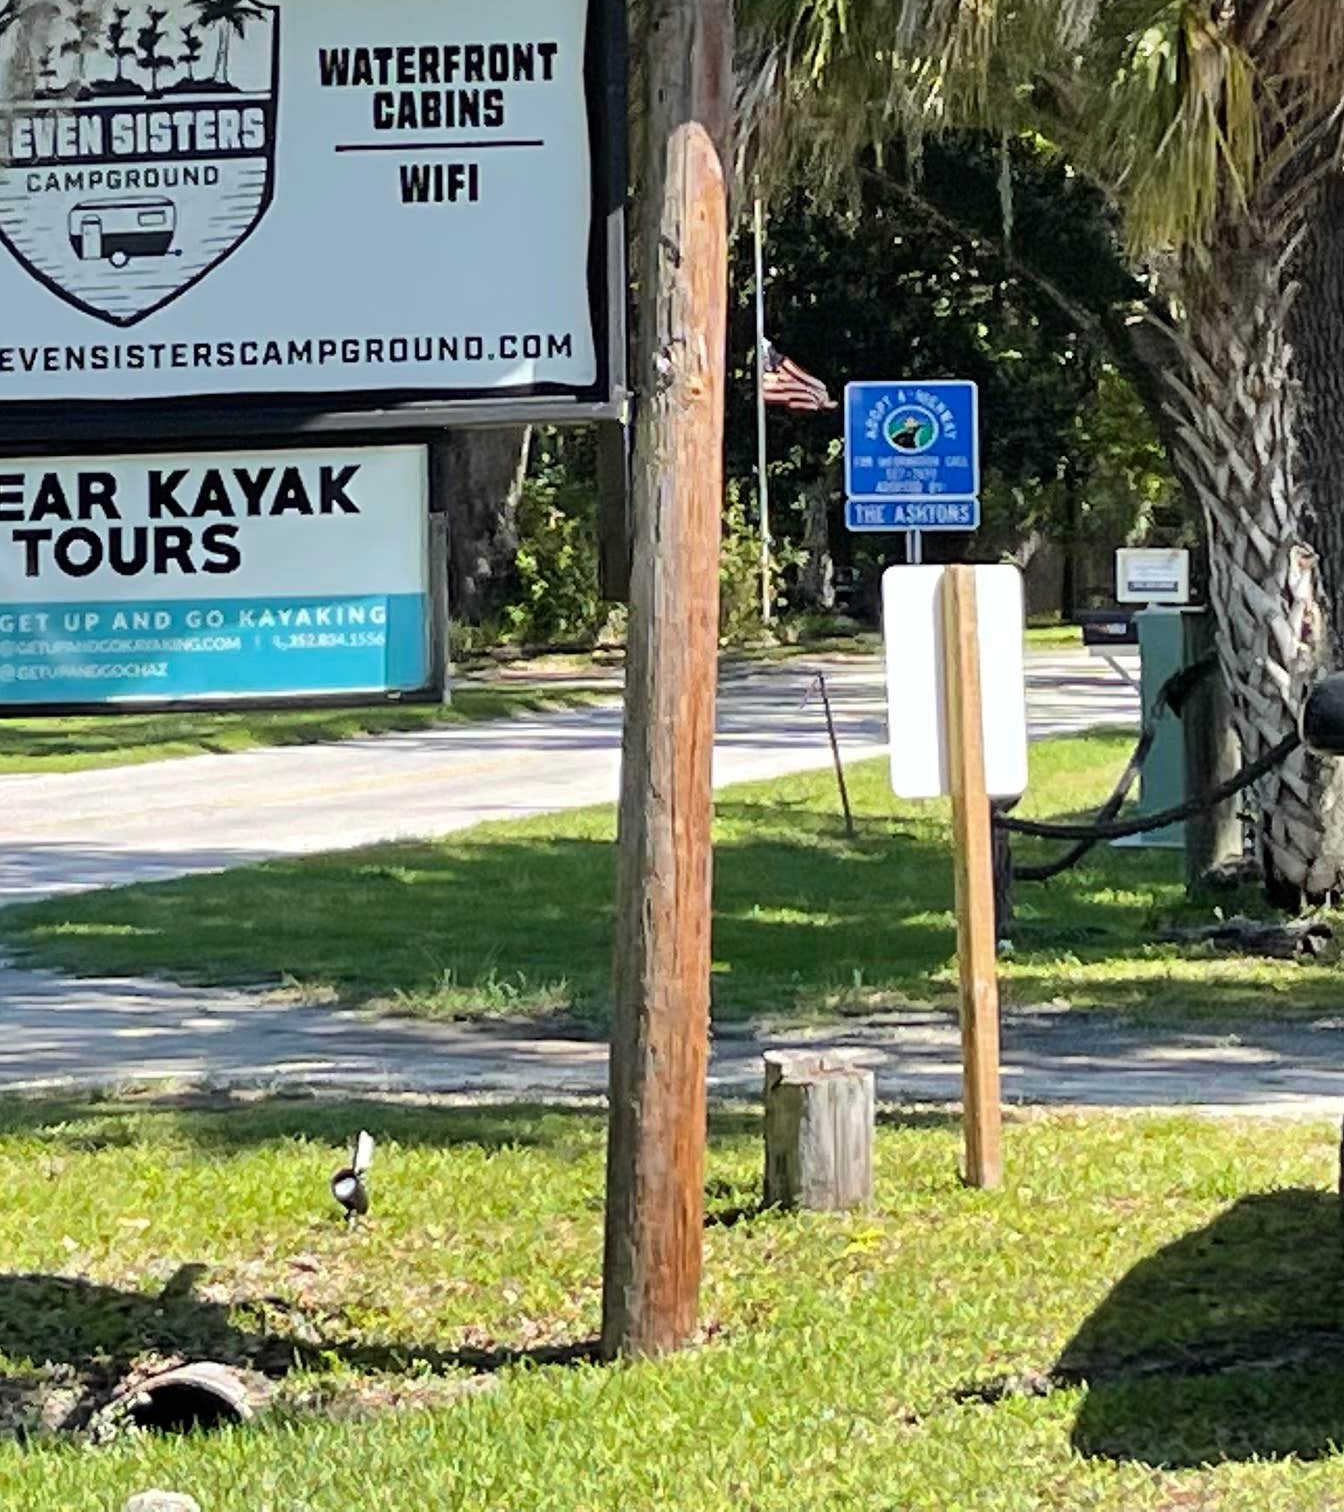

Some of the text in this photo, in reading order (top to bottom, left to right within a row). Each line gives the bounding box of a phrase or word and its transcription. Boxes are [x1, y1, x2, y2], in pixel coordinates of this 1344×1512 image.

[319, 42, 557, 86] WATERFRONT
[373, 89, 504, 129] CABINS
[111, 108, 266, 154] SISTERS
[26, 166, 219, 193] CAMPGROUND
[400, 164, 478, 203] WIFI
[148, 464, 361, 519] KAYAK
[855, 503, 970, 523] THE ASHTONS
[12, 524, 241, 577] TOURS
[64, 612, 99, 631] UP
[112, 611, 171, 630] AND
[186, 610, 224, 628] GO
[239, 606, 386, 628] KAYAKING
